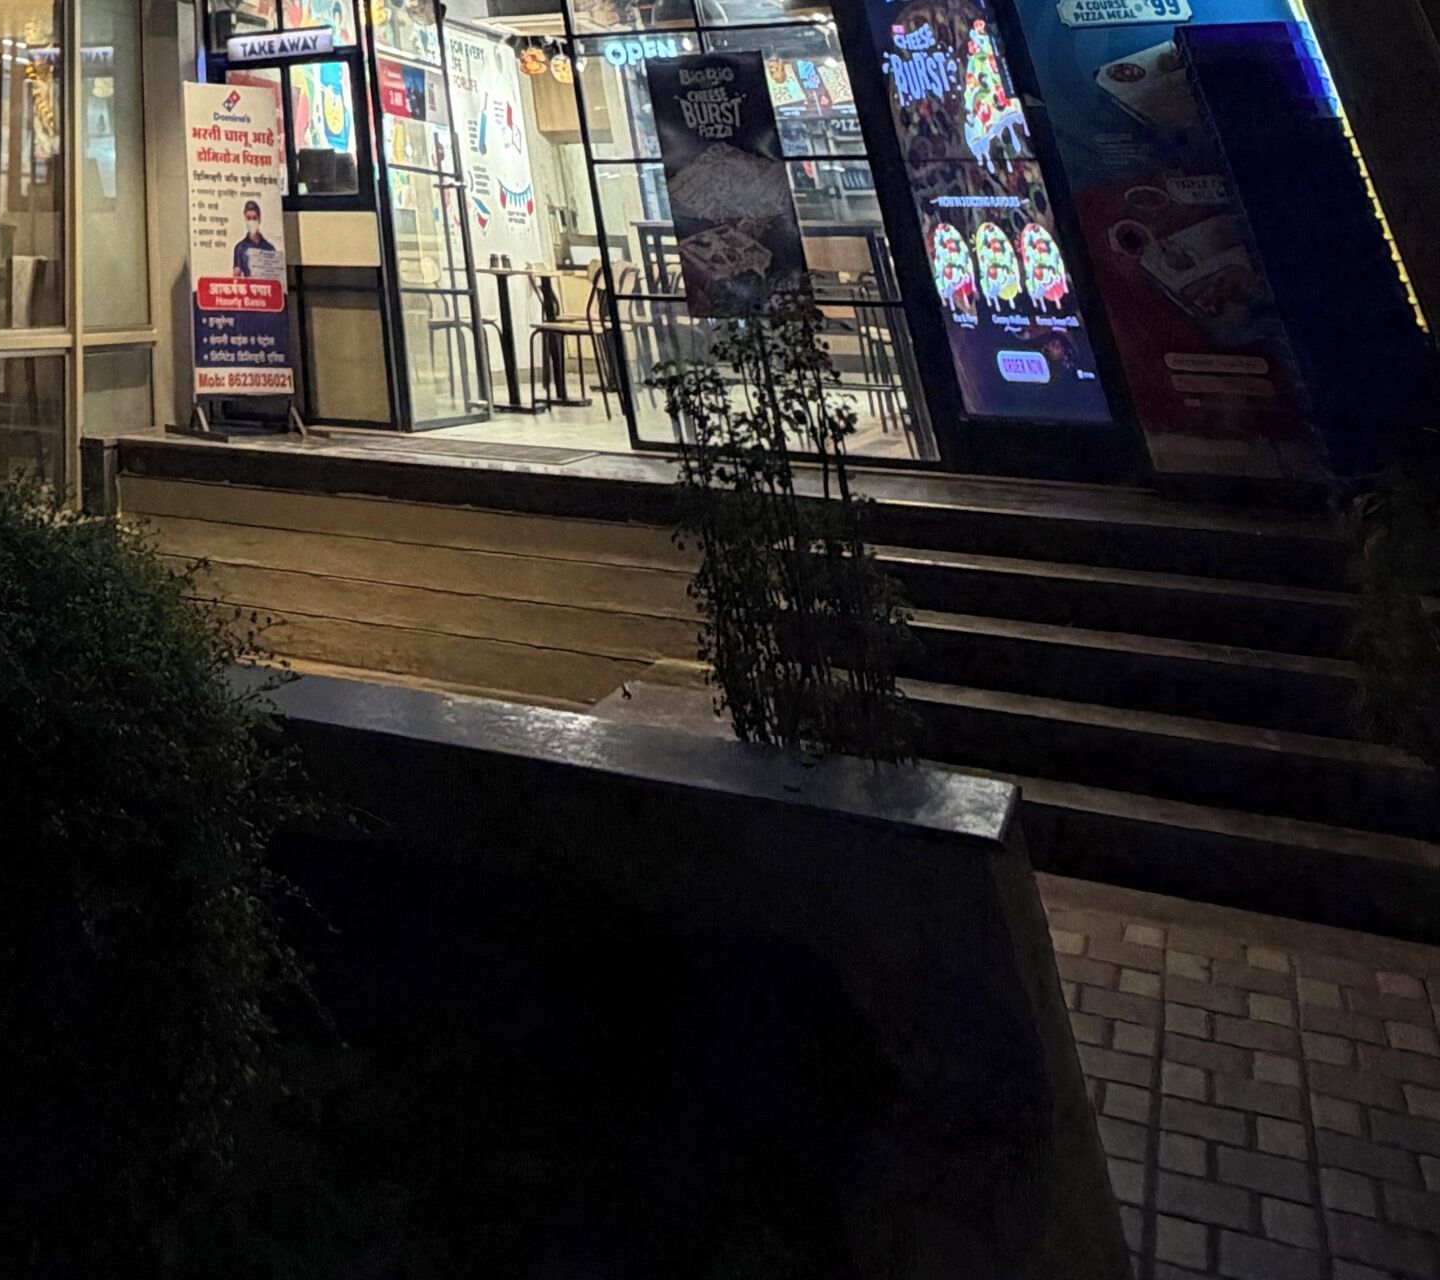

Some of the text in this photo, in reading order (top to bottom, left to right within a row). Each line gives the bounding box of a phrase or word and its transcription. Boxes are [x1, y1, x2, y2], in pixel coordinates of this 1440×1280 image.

[1073, 8, 1138, 23] PIZZA MEAL
[1075, 0, 1084, 11] 4
[239, 35, 319, 58] TAKE AWAY
[892, 22, 936, 51] CHEESE
[604, 38, 678, 66] OPEN
[889, 51, 951, 107] BURST
[687, 87, 730, 103] CHEESE
[213, 111, 251, 123] Domino's
[679, 97, 742, 129] BURST
[192, 124, 275, 148] भरती चालू आहे
[198, 372, 226, 388] Mob:
